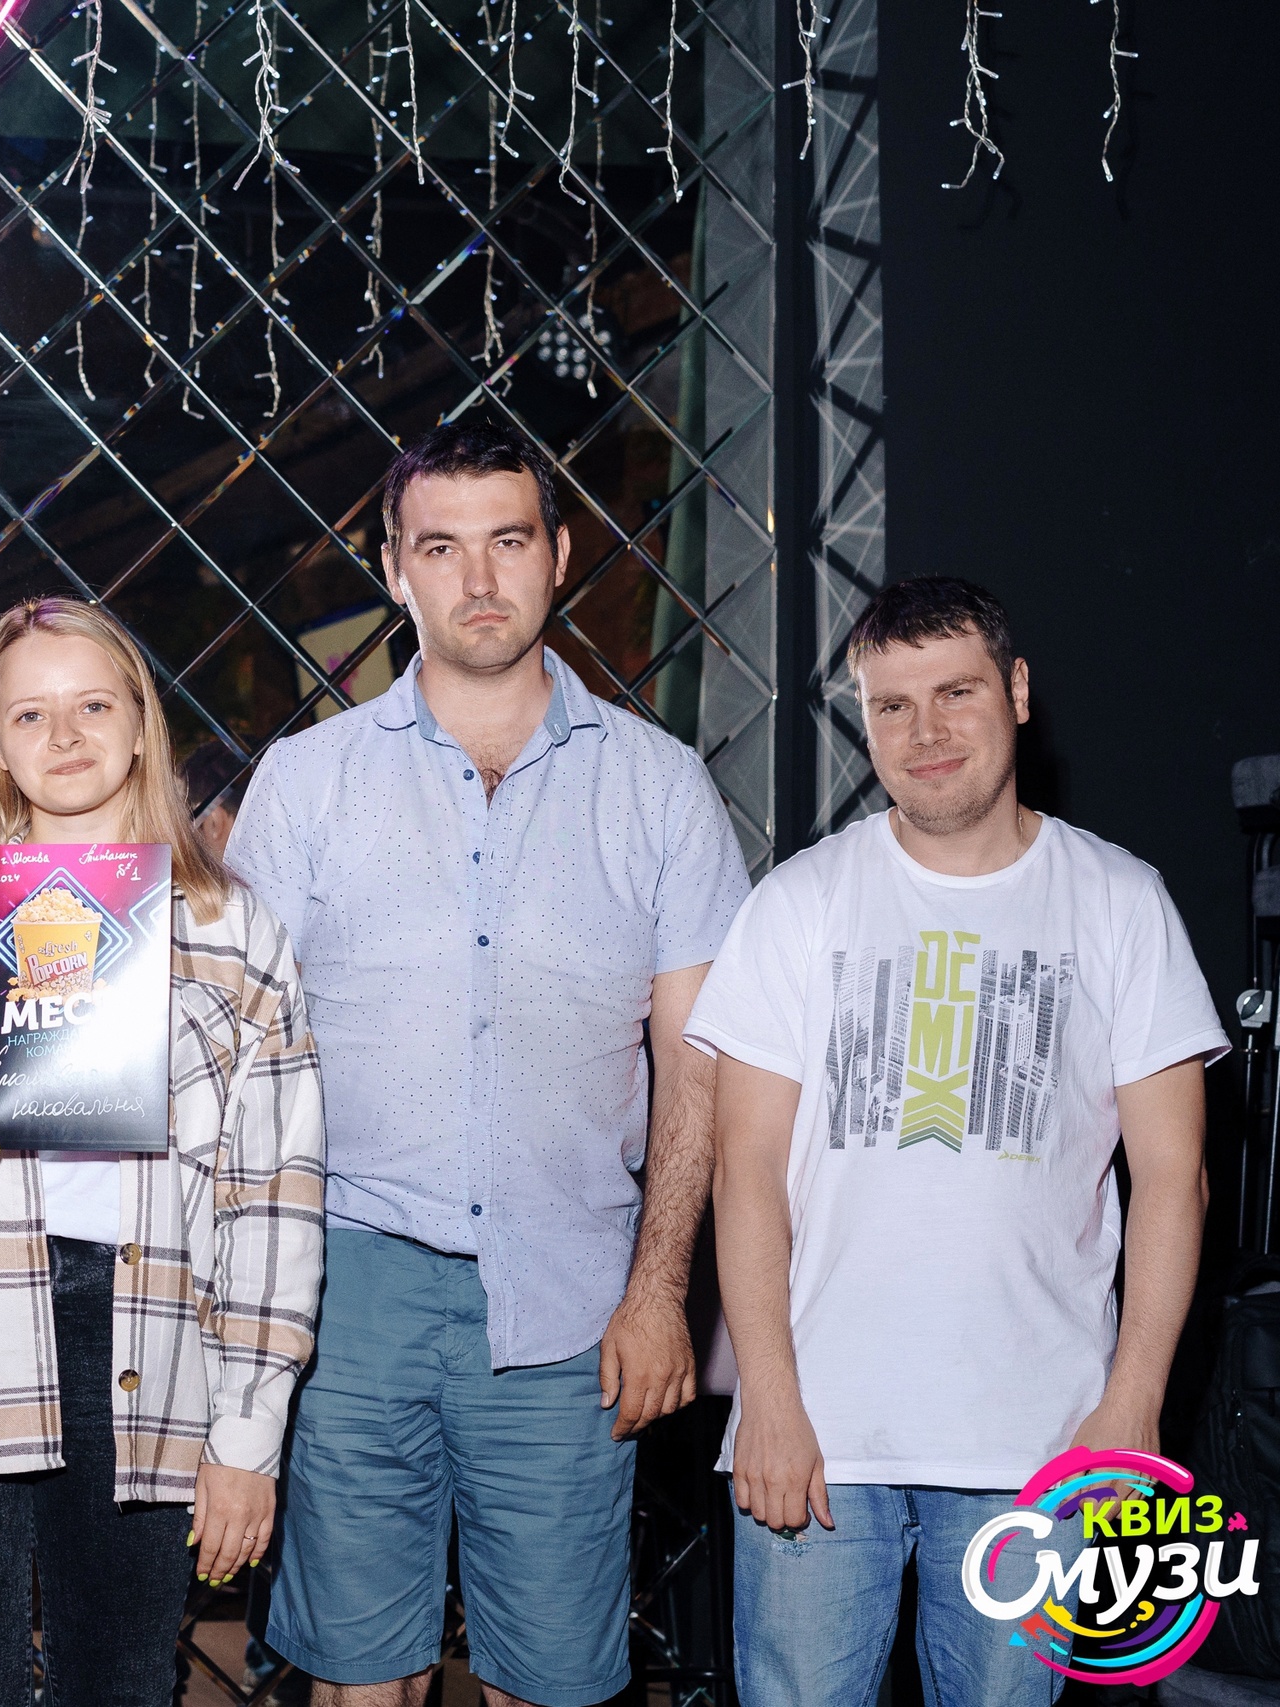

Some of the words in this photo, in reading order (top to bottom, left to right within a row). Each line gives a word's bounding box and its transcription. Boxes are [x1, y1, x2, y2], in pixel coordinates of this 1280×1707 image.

[10, 852, 50, 865] Москва
[1, 991, 100, 1035] МЕС
[7, 1028, 82, 1047] НАГРАЖДА
[11, 1092, 145, 1120] наковальня
